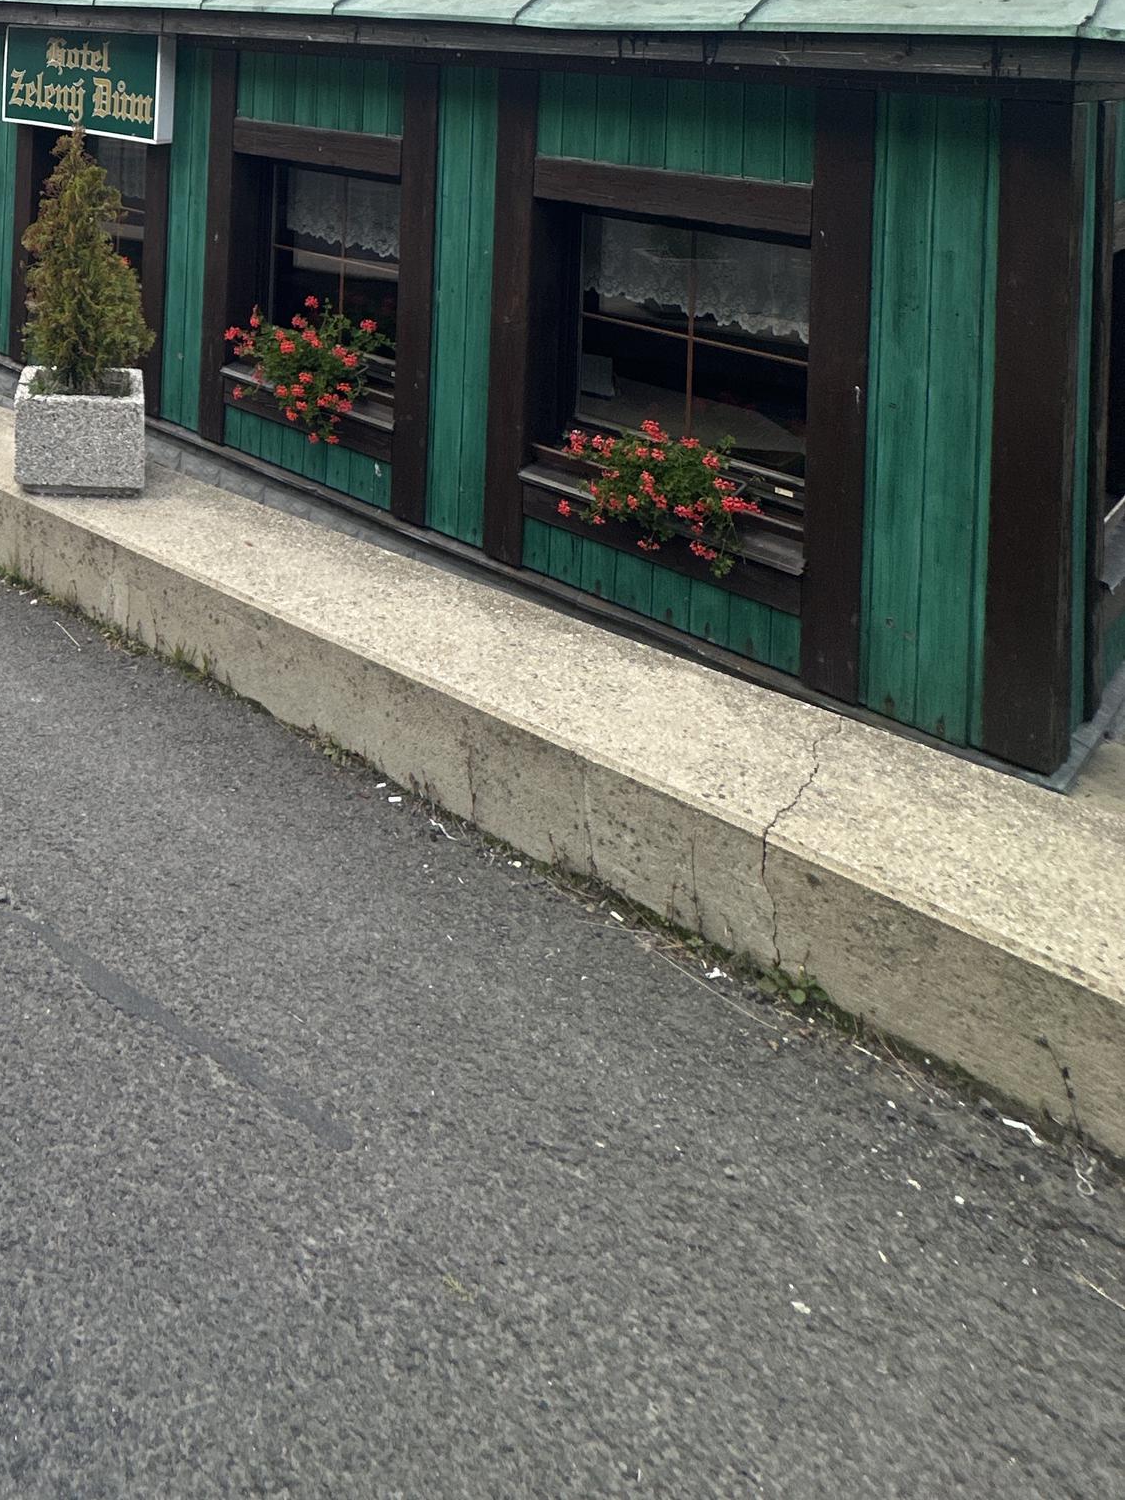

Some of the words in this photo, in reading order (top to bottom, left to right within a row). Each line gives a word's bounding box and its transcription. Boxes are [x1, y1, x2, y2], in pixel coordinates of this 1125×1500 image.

[46, 37, 111, 75] Hotel
[9, 68, 85, 122] Zelený
[92, 77, 153, 124] Dům
